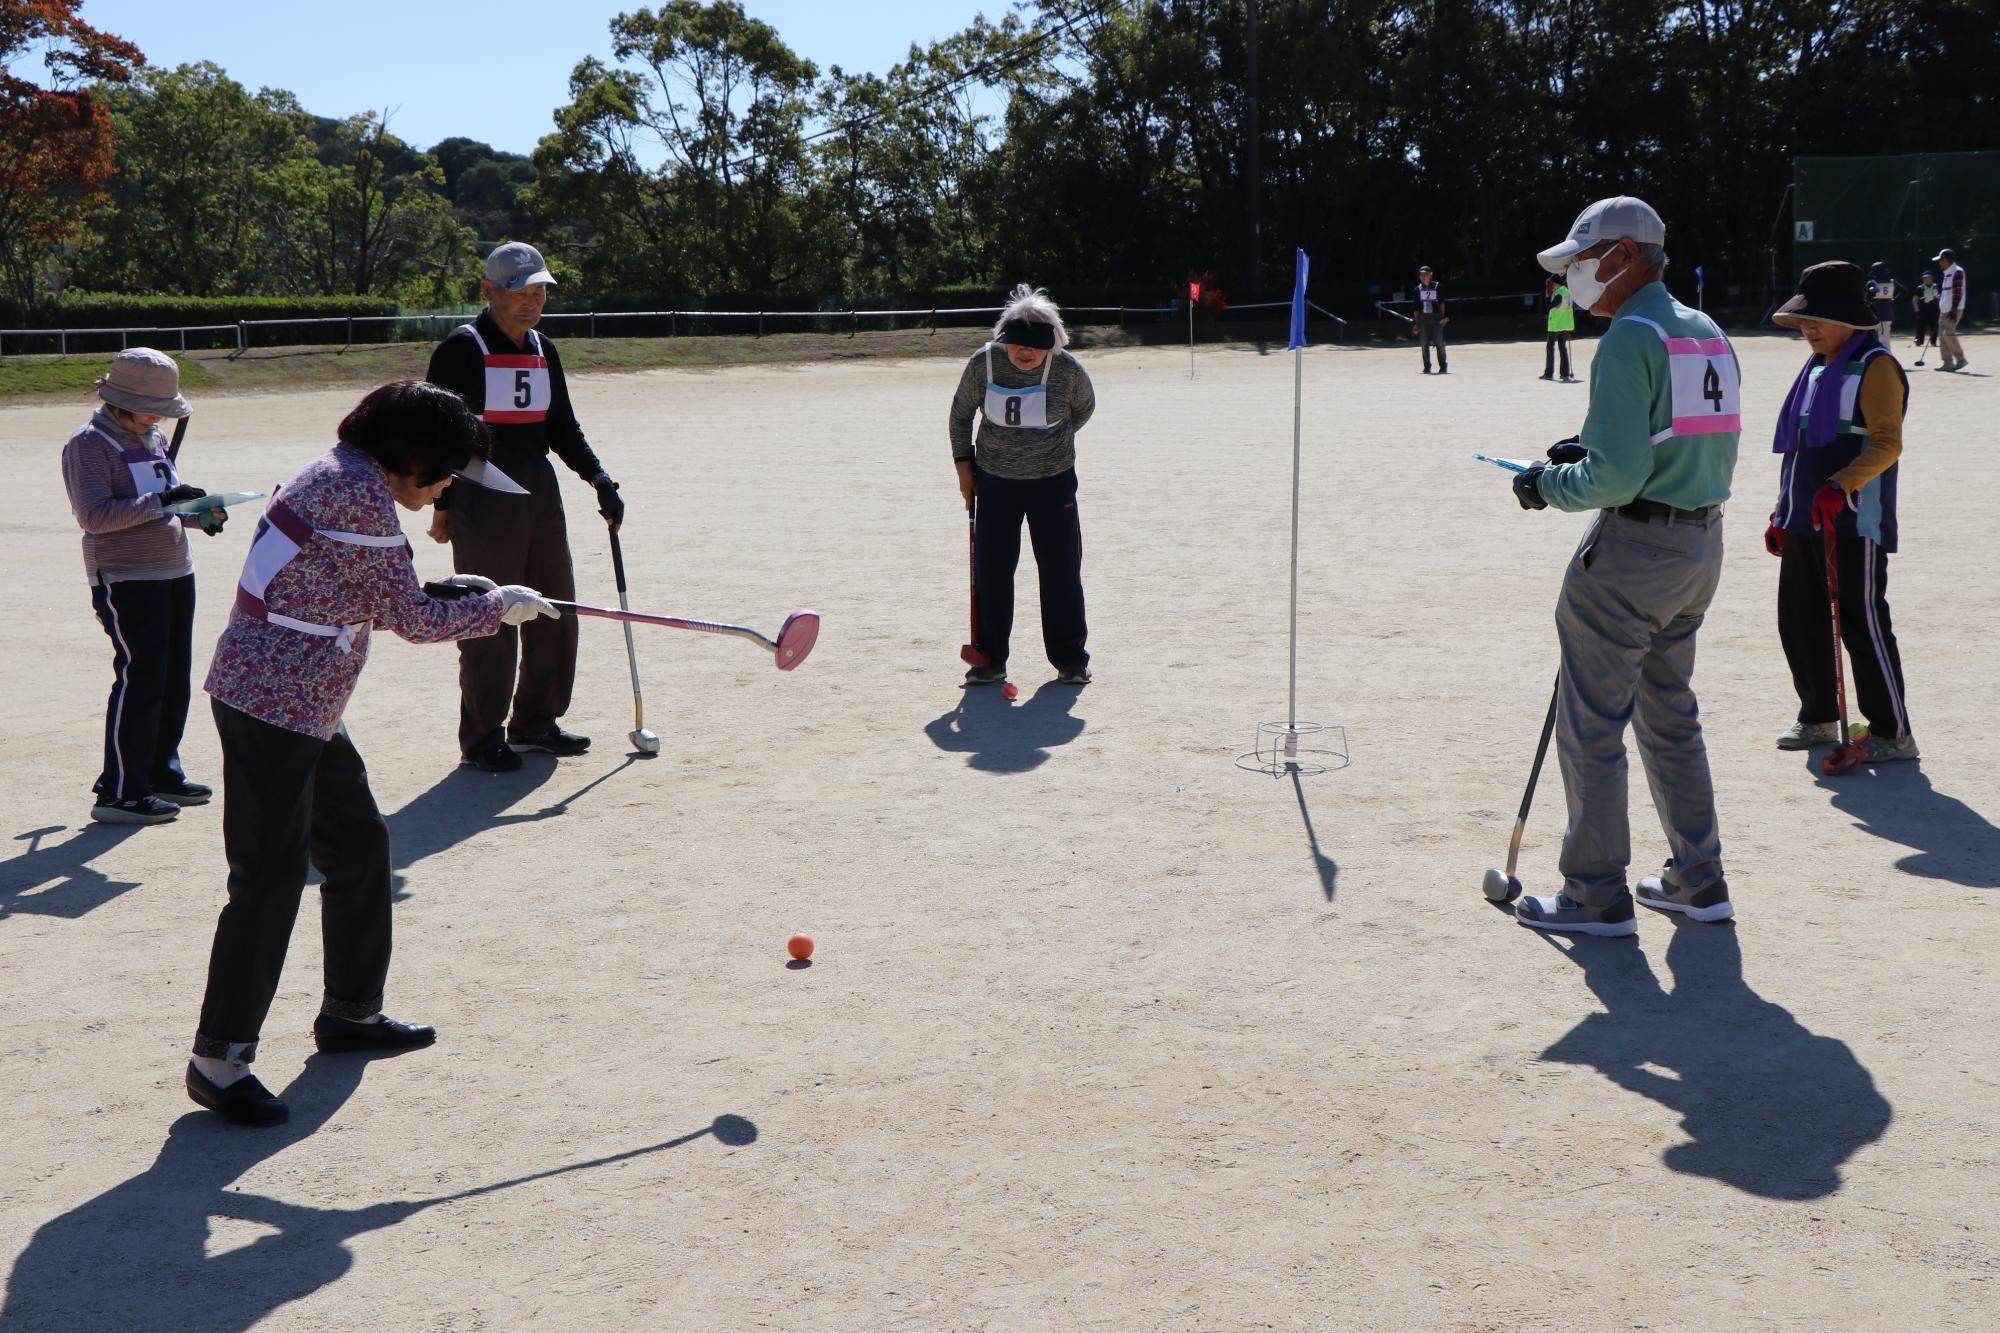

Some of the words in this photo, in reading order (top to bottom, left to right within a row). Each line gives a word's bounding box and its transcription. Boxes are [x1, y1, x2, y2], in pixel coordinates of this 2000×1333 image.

[1798, 223, 1809, 240] A
[1426, 291, 1431, 299] 2
[1883, 286, 1889, 296] 6
[514, 370, 532, 409] 5
[1703, 359, 1723, 412] 4
[1005, 396, 1022, 426] 8
